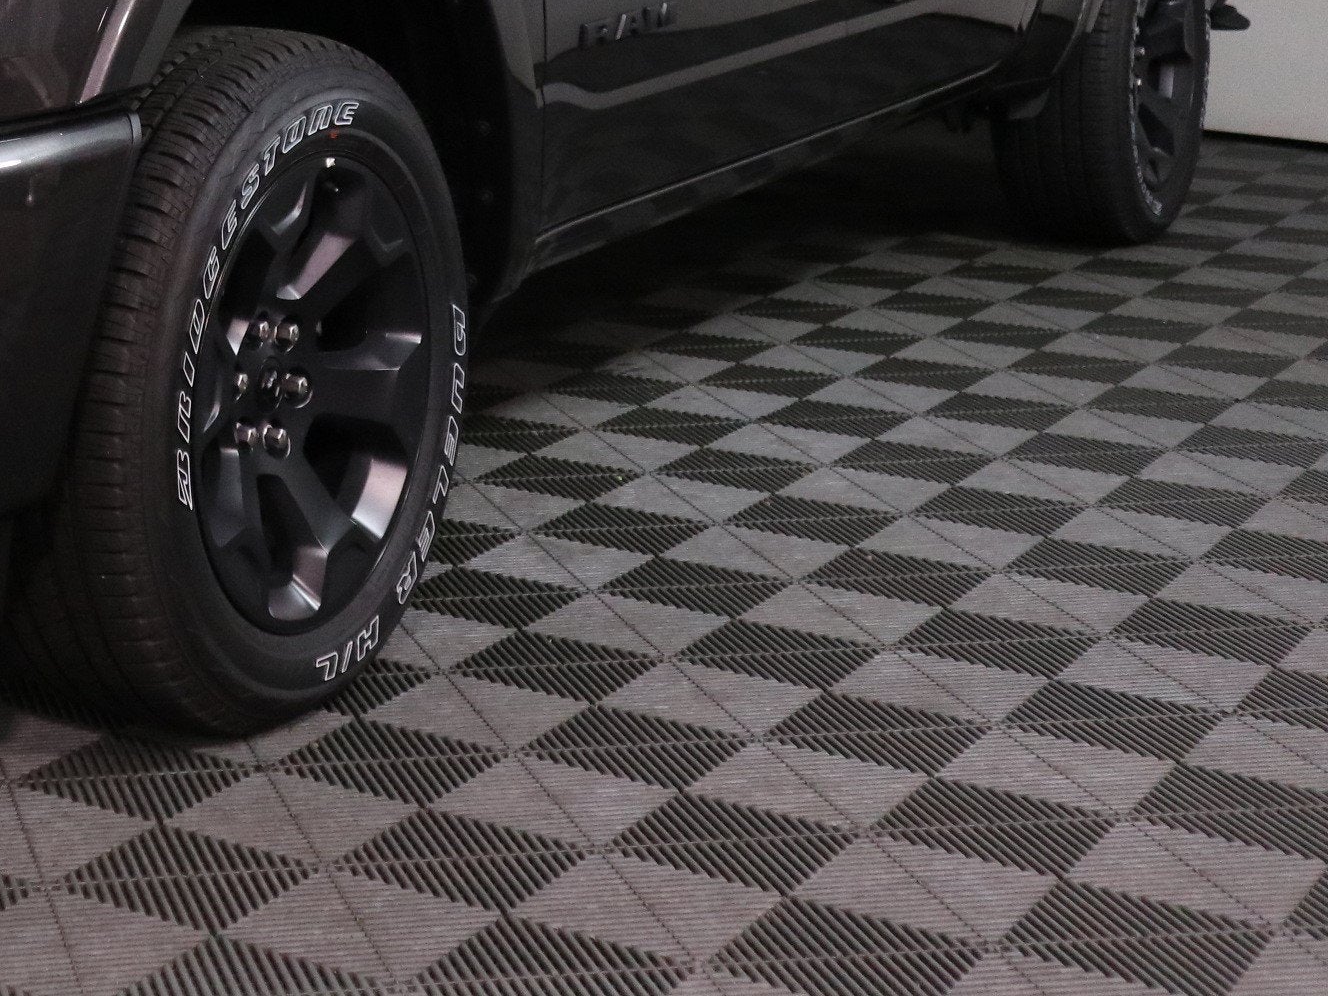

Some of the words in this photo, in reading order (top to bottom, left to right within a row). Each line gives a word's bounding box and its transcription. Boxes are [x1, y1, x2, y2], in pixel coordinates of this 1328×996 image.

[177, 101, 359, 510] BRIDGESTONE
[395, 303, 468, 605] DUELER
[315, 614, 380, 682] H/L
